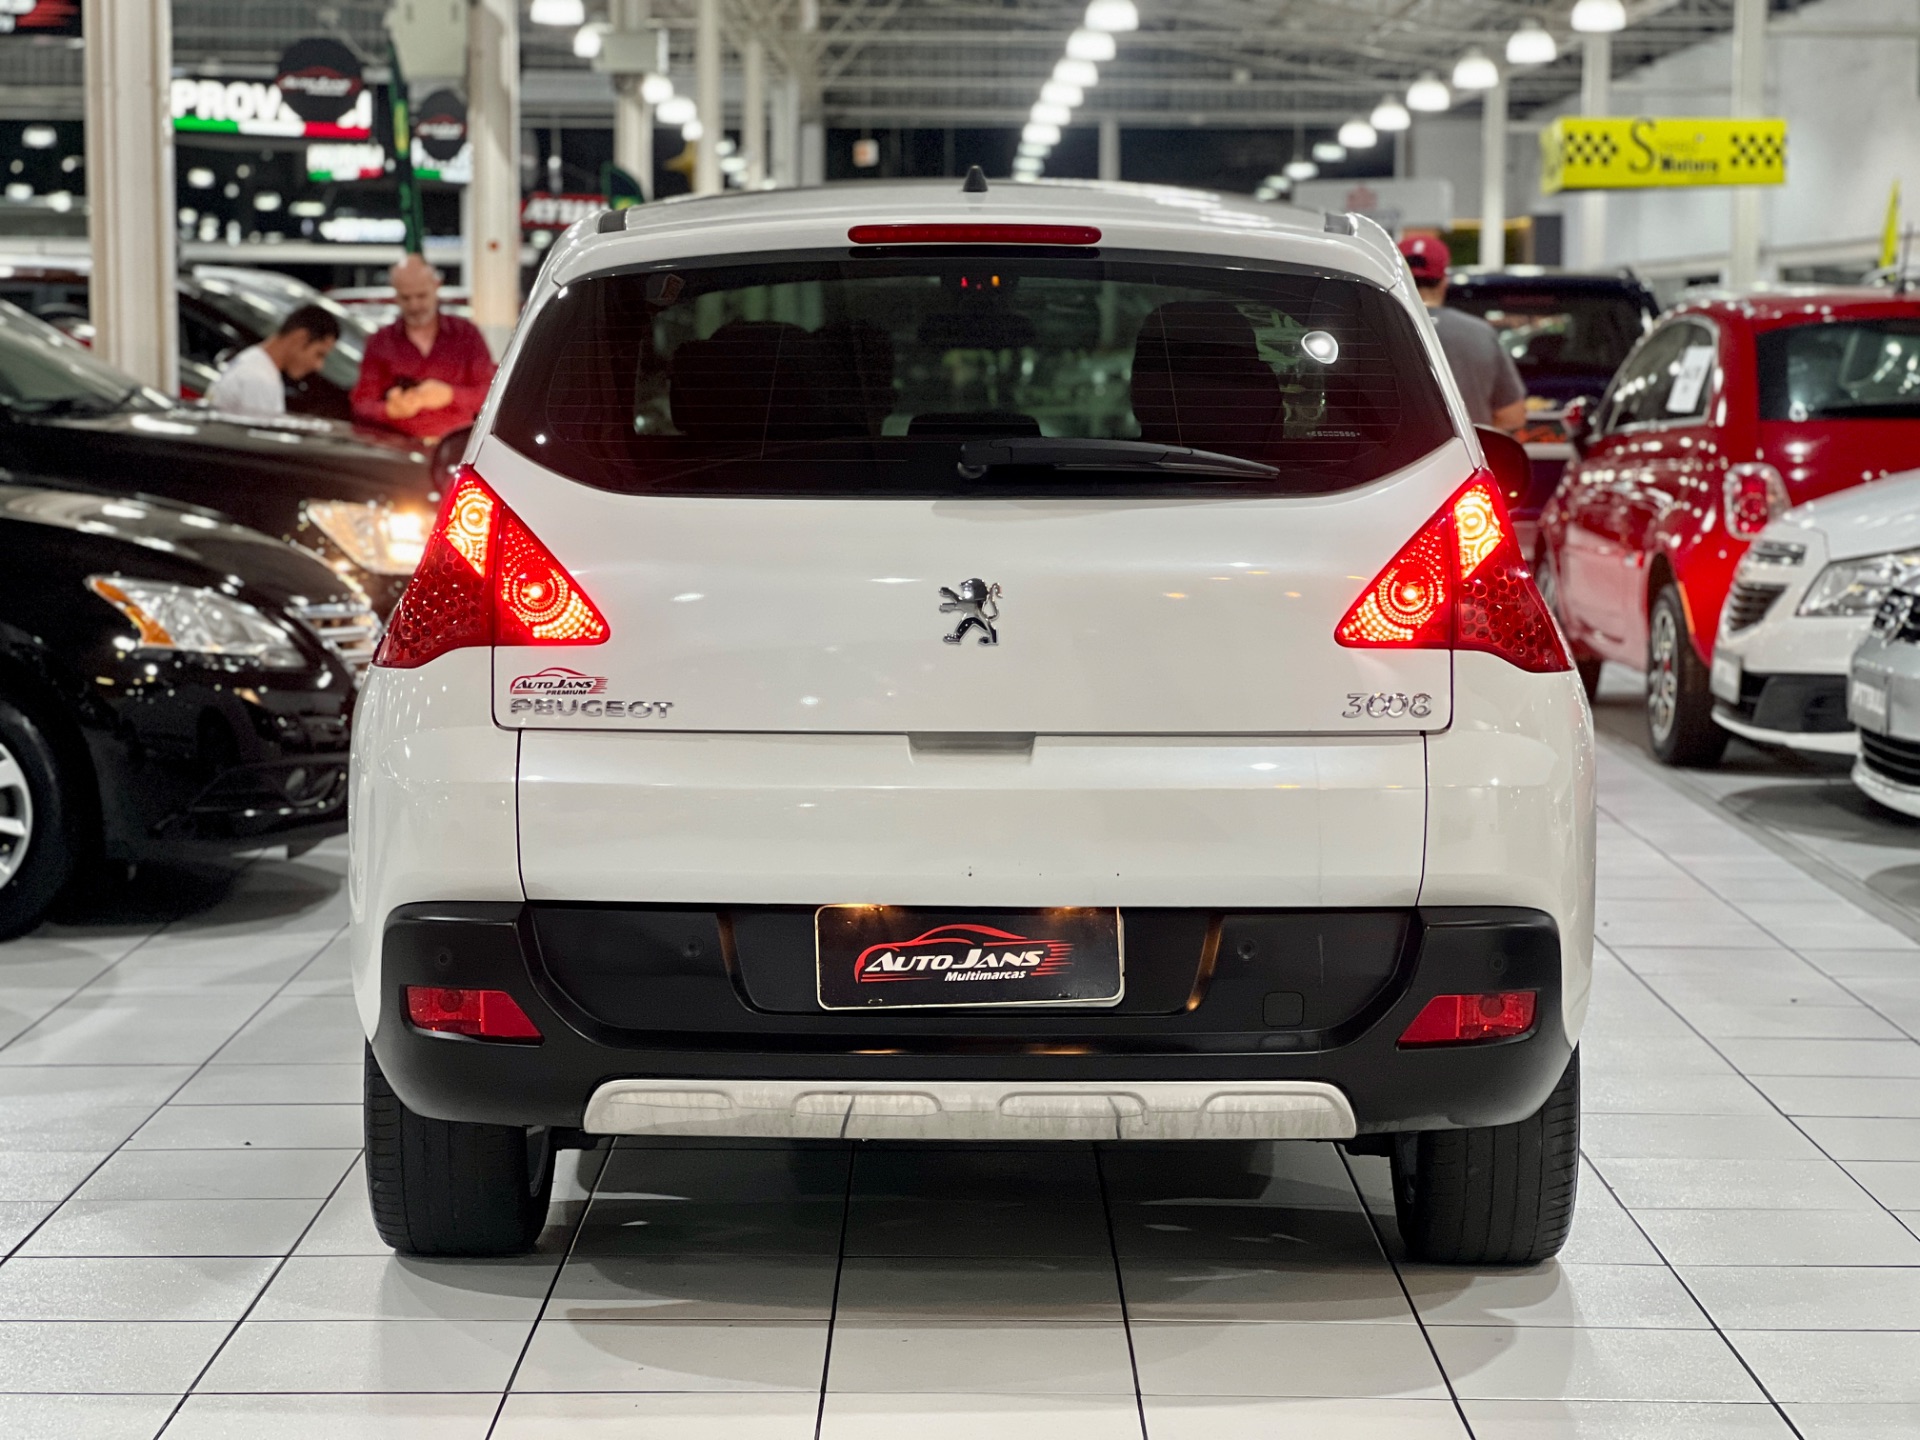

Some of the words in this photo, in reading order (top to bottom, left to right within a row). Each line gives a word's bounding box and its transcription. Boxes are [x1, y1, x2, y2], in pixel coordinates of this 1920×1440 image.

[510, 697, 675, 719] PEUGEOT
[1342, 692, 1432, 718] 3008
[944, 970, 1027, 982] Multimarcas
